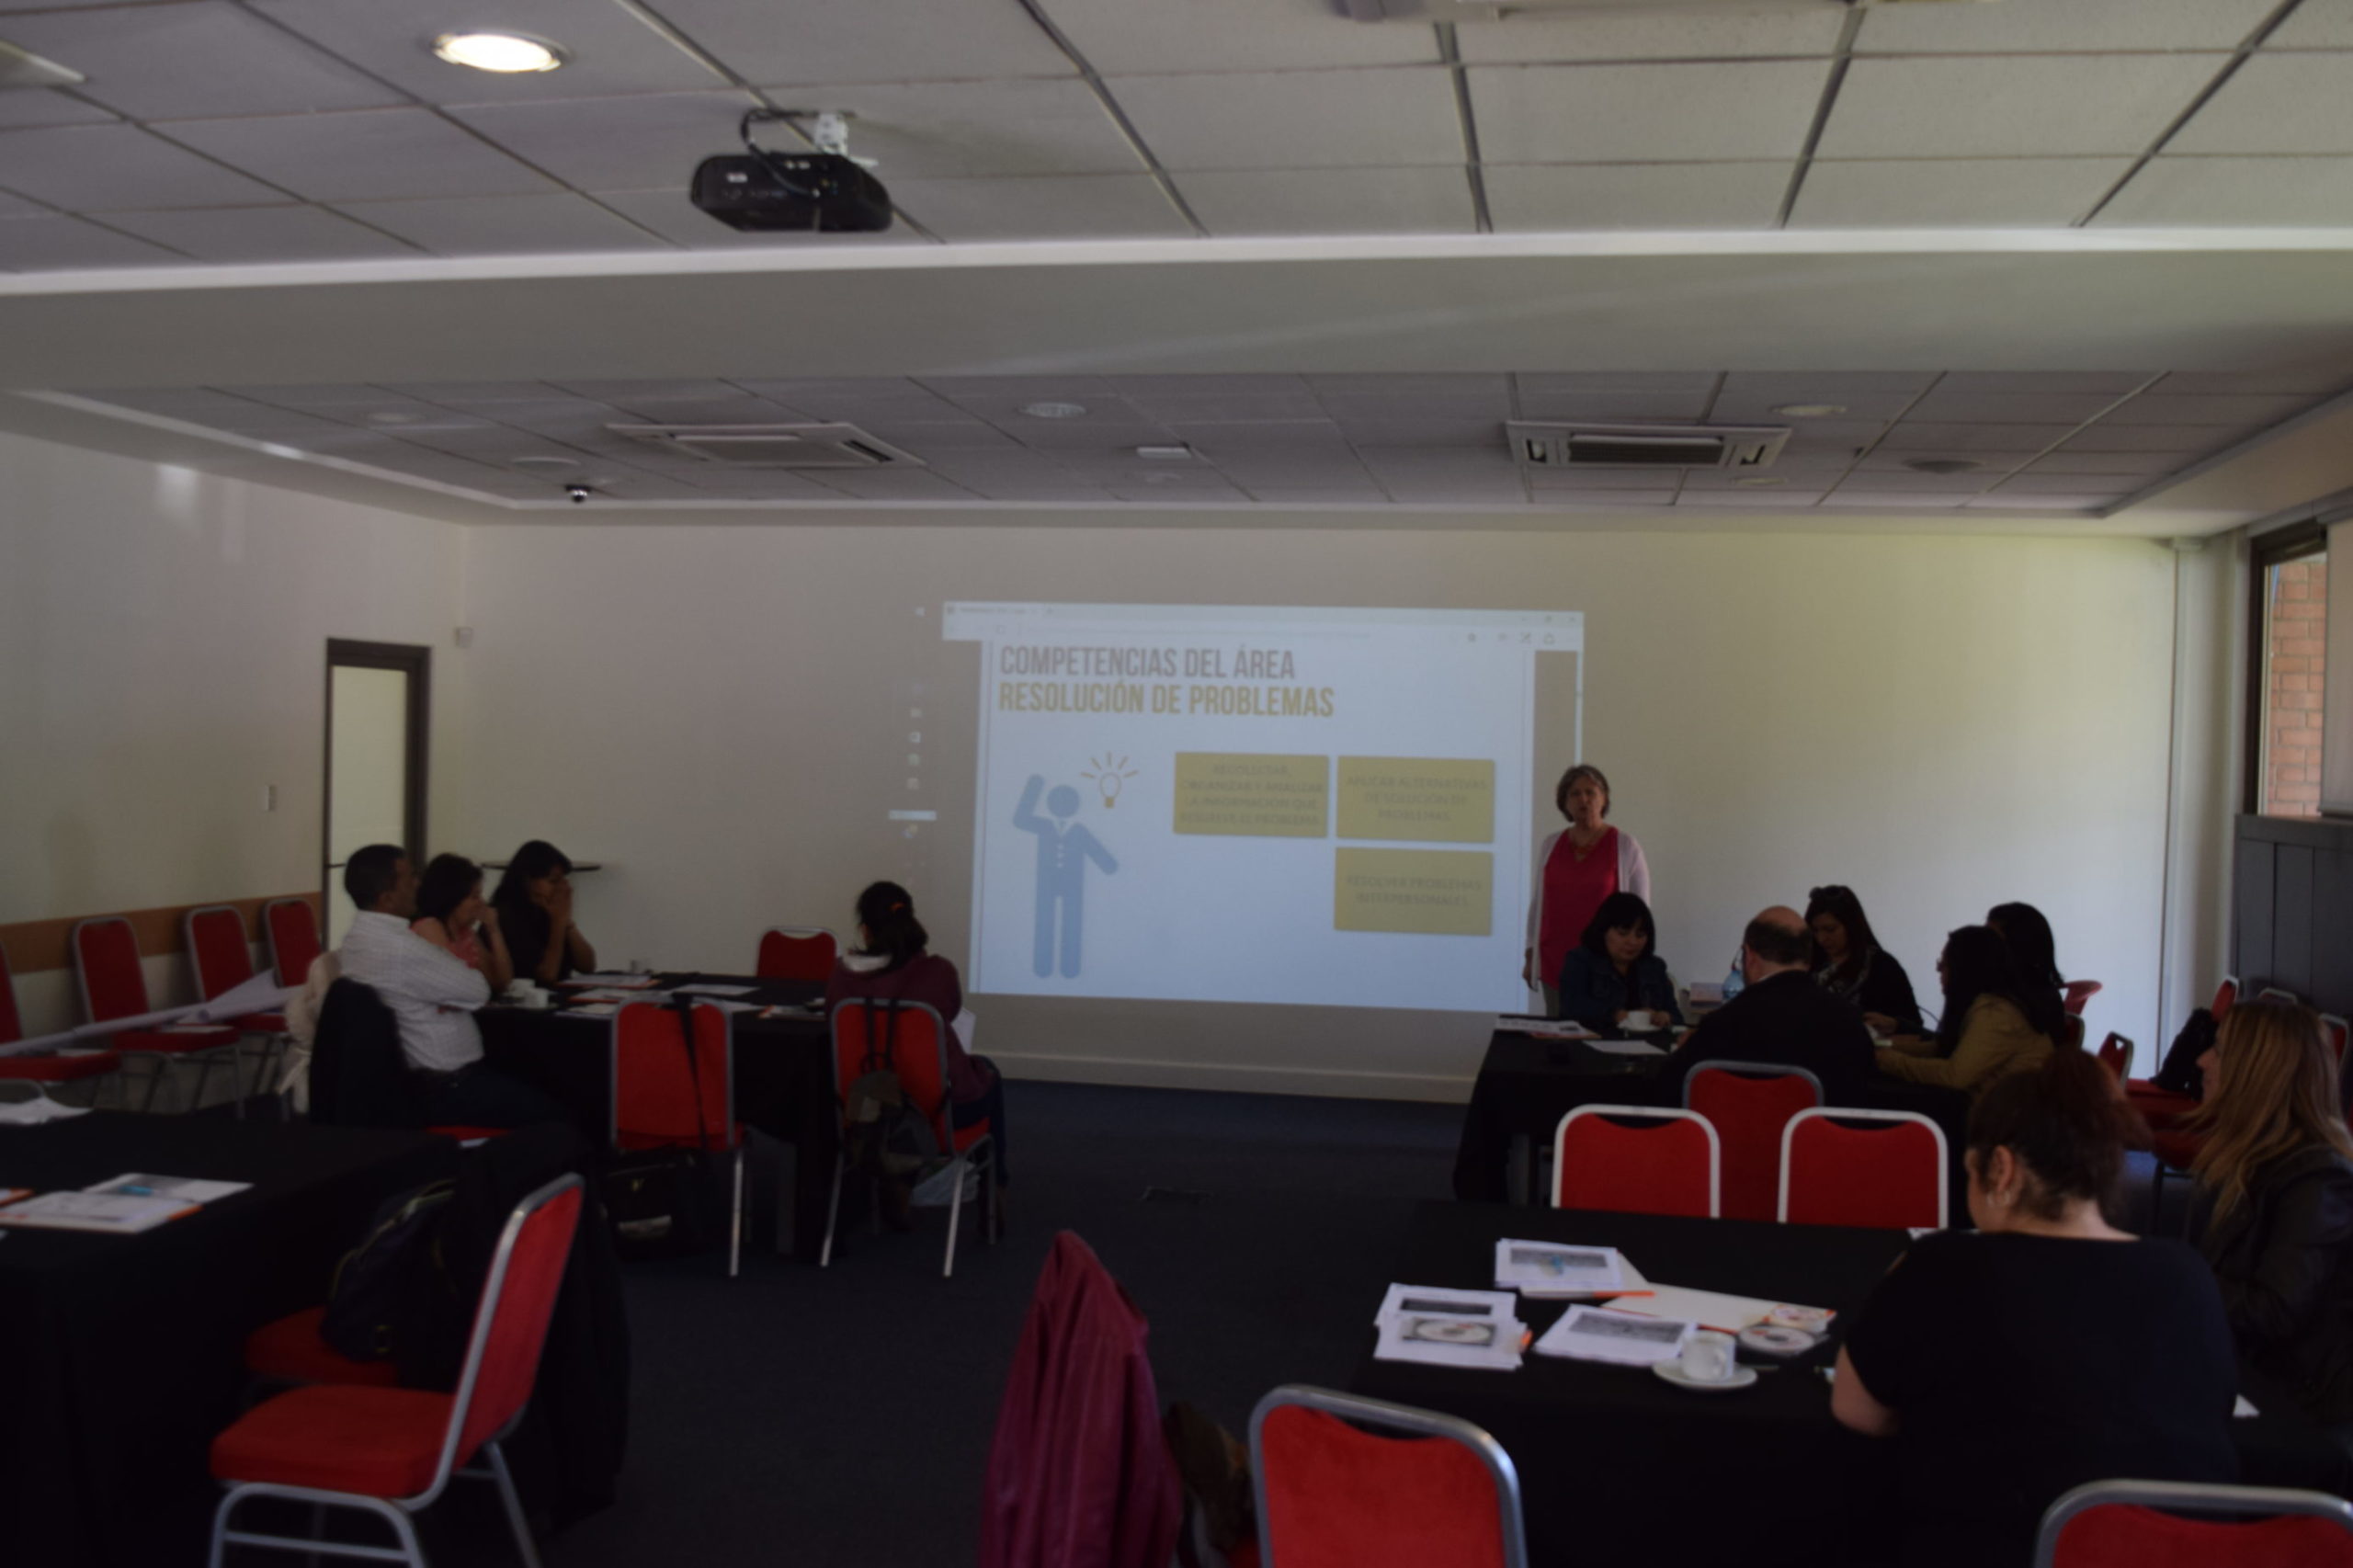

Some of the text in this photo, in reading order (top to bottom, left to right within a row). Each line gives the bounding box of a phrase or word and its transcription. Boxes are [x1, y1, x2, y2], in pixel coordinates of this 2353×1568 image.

[1000, 643, 1295, 679] COMPETENCIAS DEL ÁREA
[999, 678, 1335, 718] RESOLUCIÓN DE PROBLEMAS
